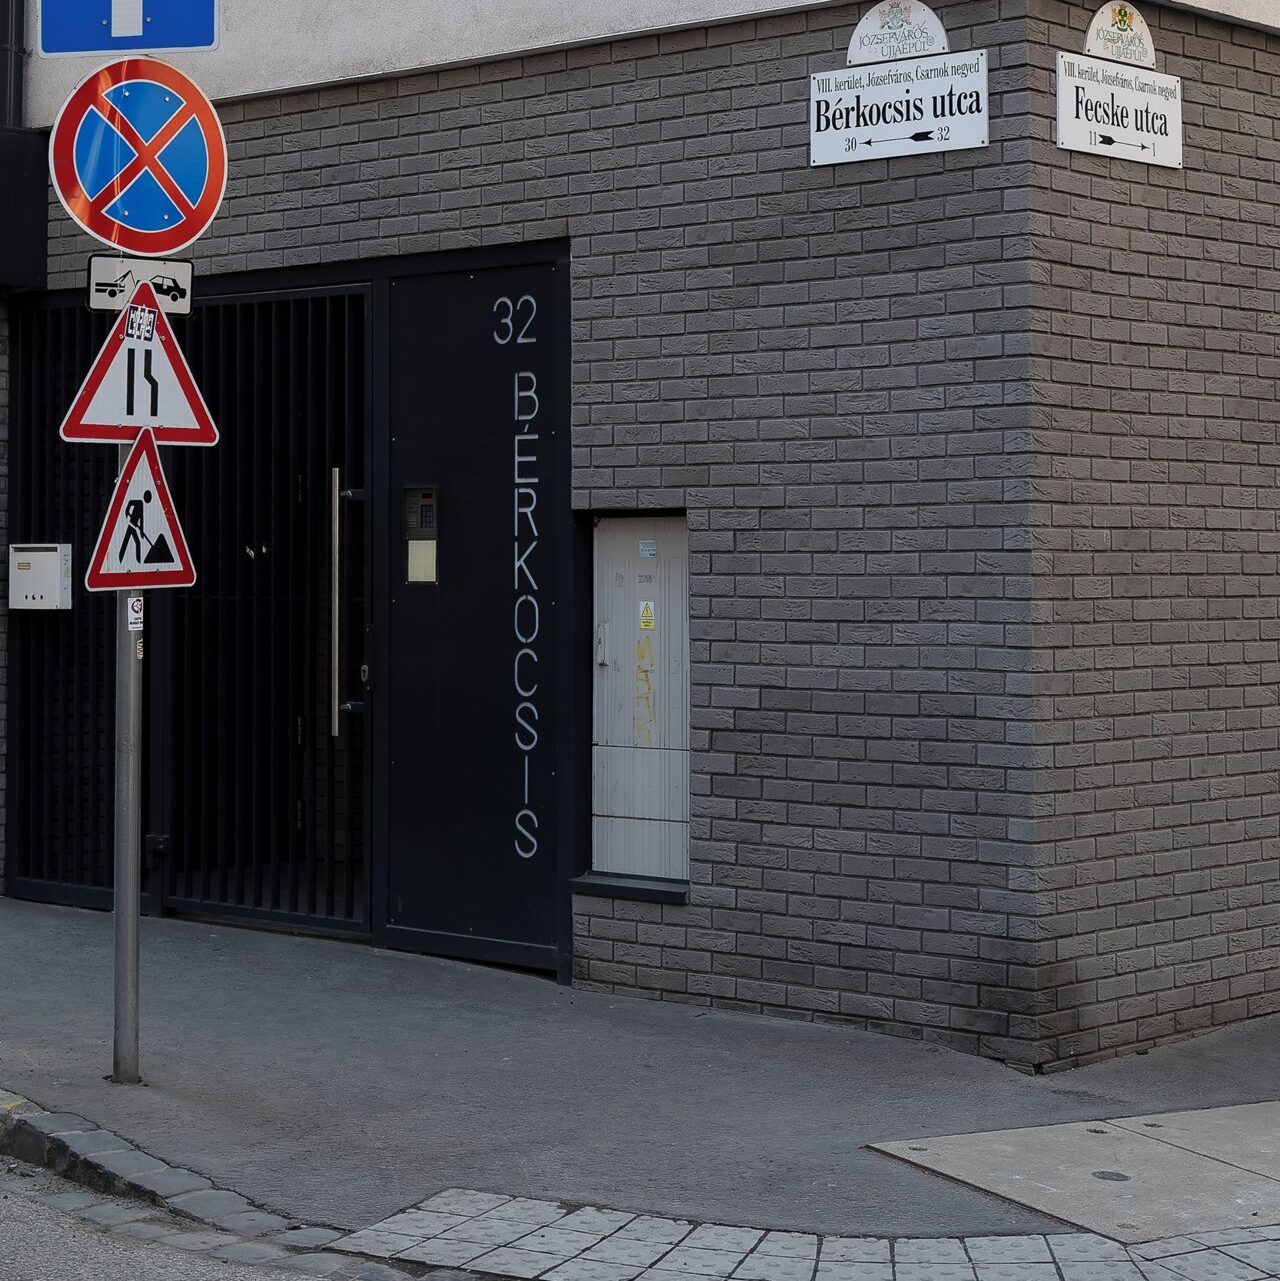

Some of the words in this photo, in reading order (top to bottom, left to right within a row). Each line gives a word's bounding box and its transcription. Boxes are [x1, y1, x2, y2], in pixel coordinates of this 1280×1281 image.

[858, 21, 929, 50] JÓZSEFVÁROS
[817, 78, 833, 94] VIII.
[834, 75, 865, 91] kerület,
[866, 68, 914, 87] Józsefváros,
[915, 62, 950, 81] Csarnok
[951, 58, 980, 78] negyed
[1064, 60, 1076, 77] VIII.
[1077, 63, 1100, 83] kerület,
[1101, 69, 1134, 91] Józsefváros,
[1135, 76, 1158, 95] Csarnok
[1158, 85, 1177, 101] negyed
[815, 88, 924, 132] Bérkocsis
[932, 84, 982, 119] utca
[1074, 85, 1130, 129] Fecske
[1134, 102, 1169, 137] utca
[844, 137, 857, 152] 30
[937, 126, 950, 141] 32
[1089, 130, 1097, 146] 11
[1152, 142, 1156, 156] 1
[493, 294, 538, 345] 32
[513, 371, 540, 859] BÉRKOCSIS
